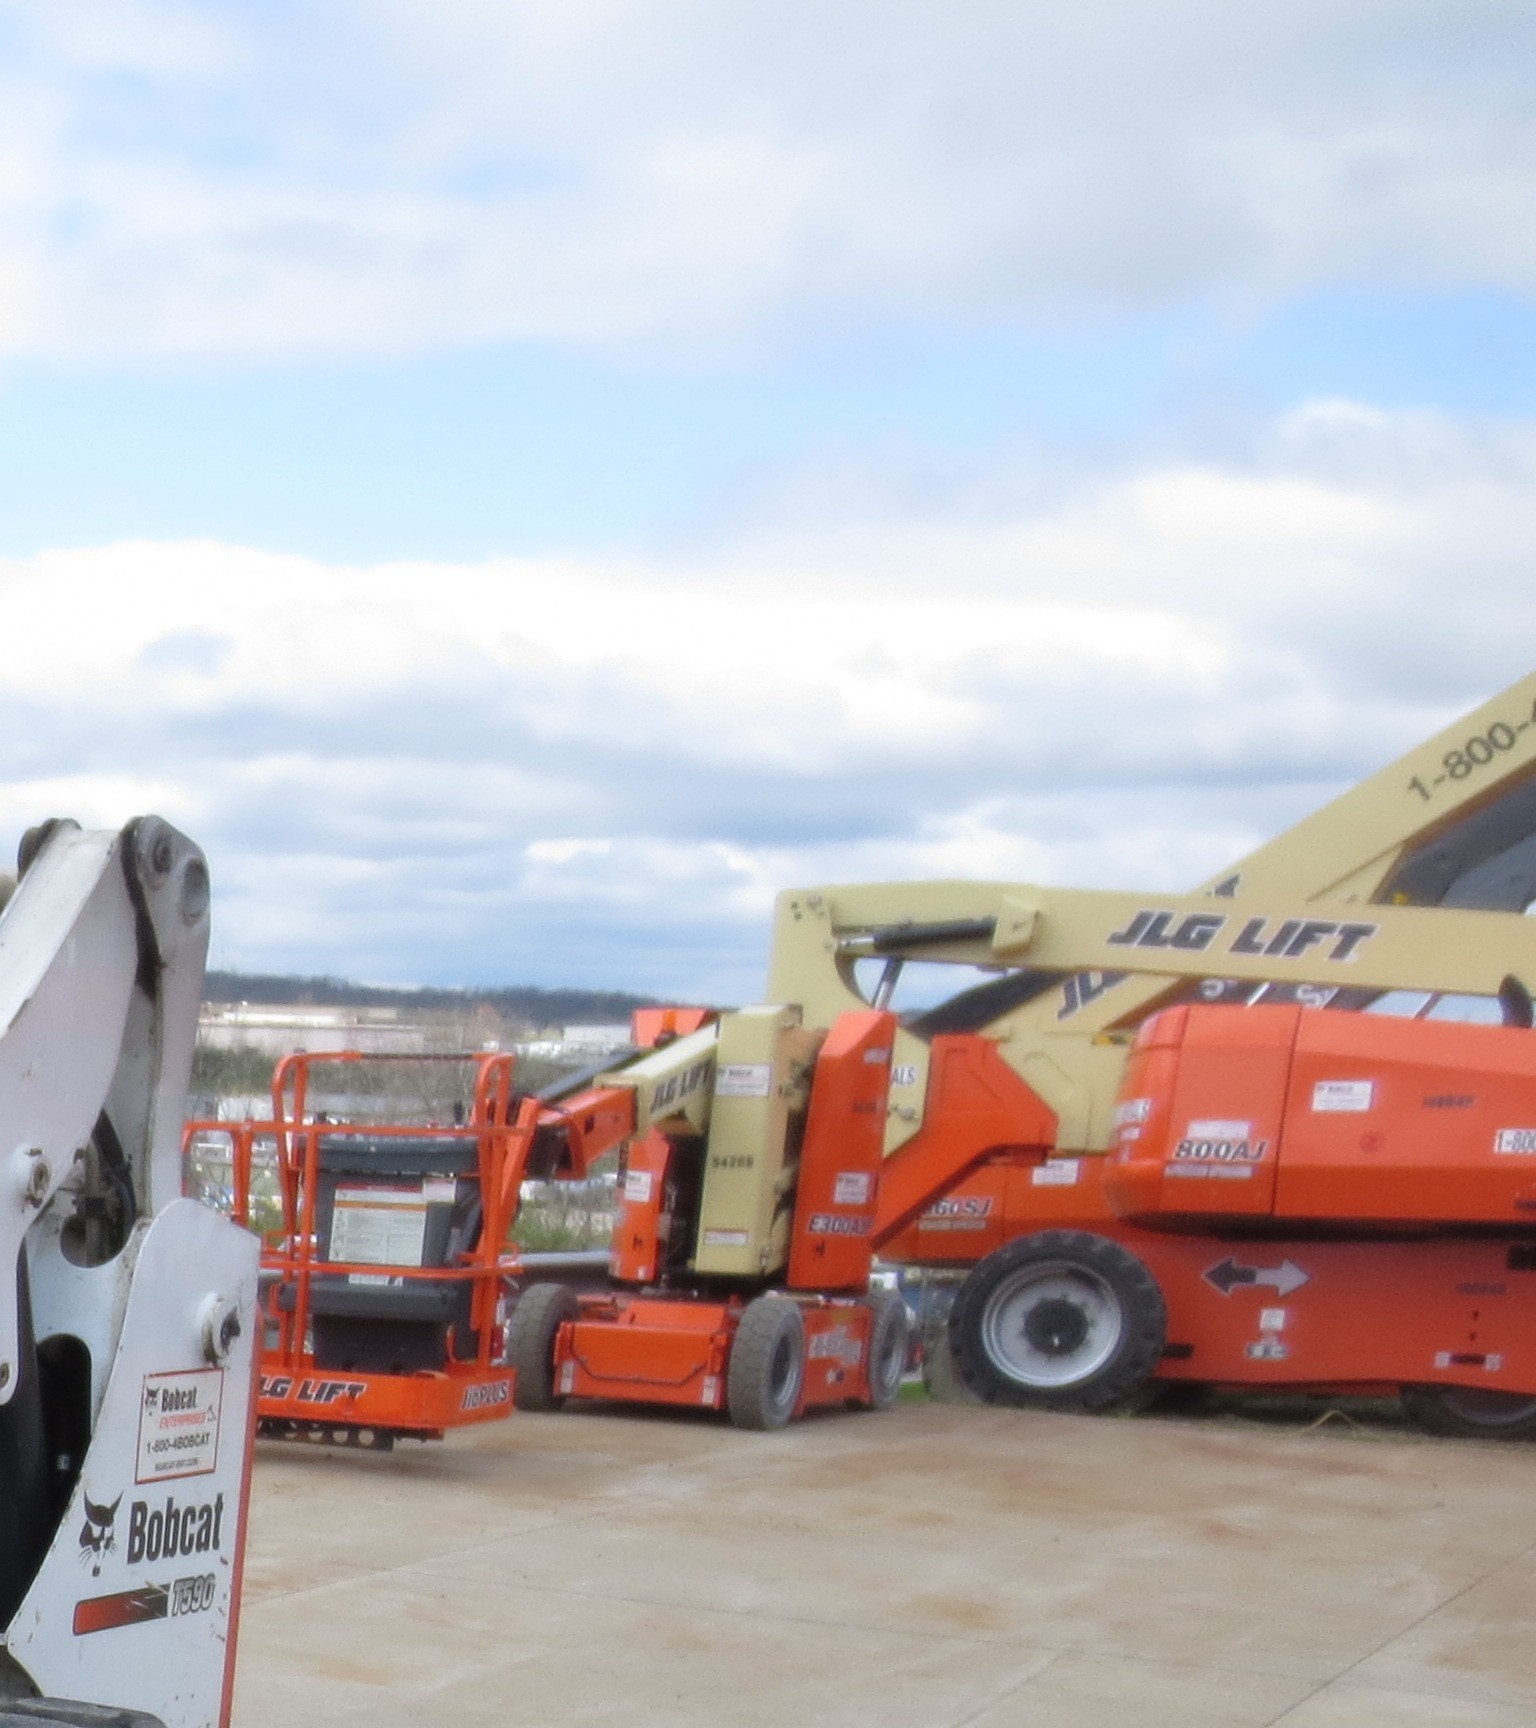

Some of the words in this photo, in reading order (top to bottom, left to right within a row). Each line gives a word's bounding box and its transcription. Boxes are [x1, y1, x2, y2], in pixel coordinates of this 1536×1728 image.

[1106, 909, 1227, 951] JLG
[1226, 916, 1380, 960] LIFT
[1174, 1138, 1268, 1160] 800AJ
[161, 1386, 198, 1412] Bobcat
[296, 1378, 369, 1404] LIFT
[147, 1432, 211, 1455] 1-800-4BOBCAT
[127, 1492, 224, 1565] Bobcat
[171, 1572, 216, 1617] T590
